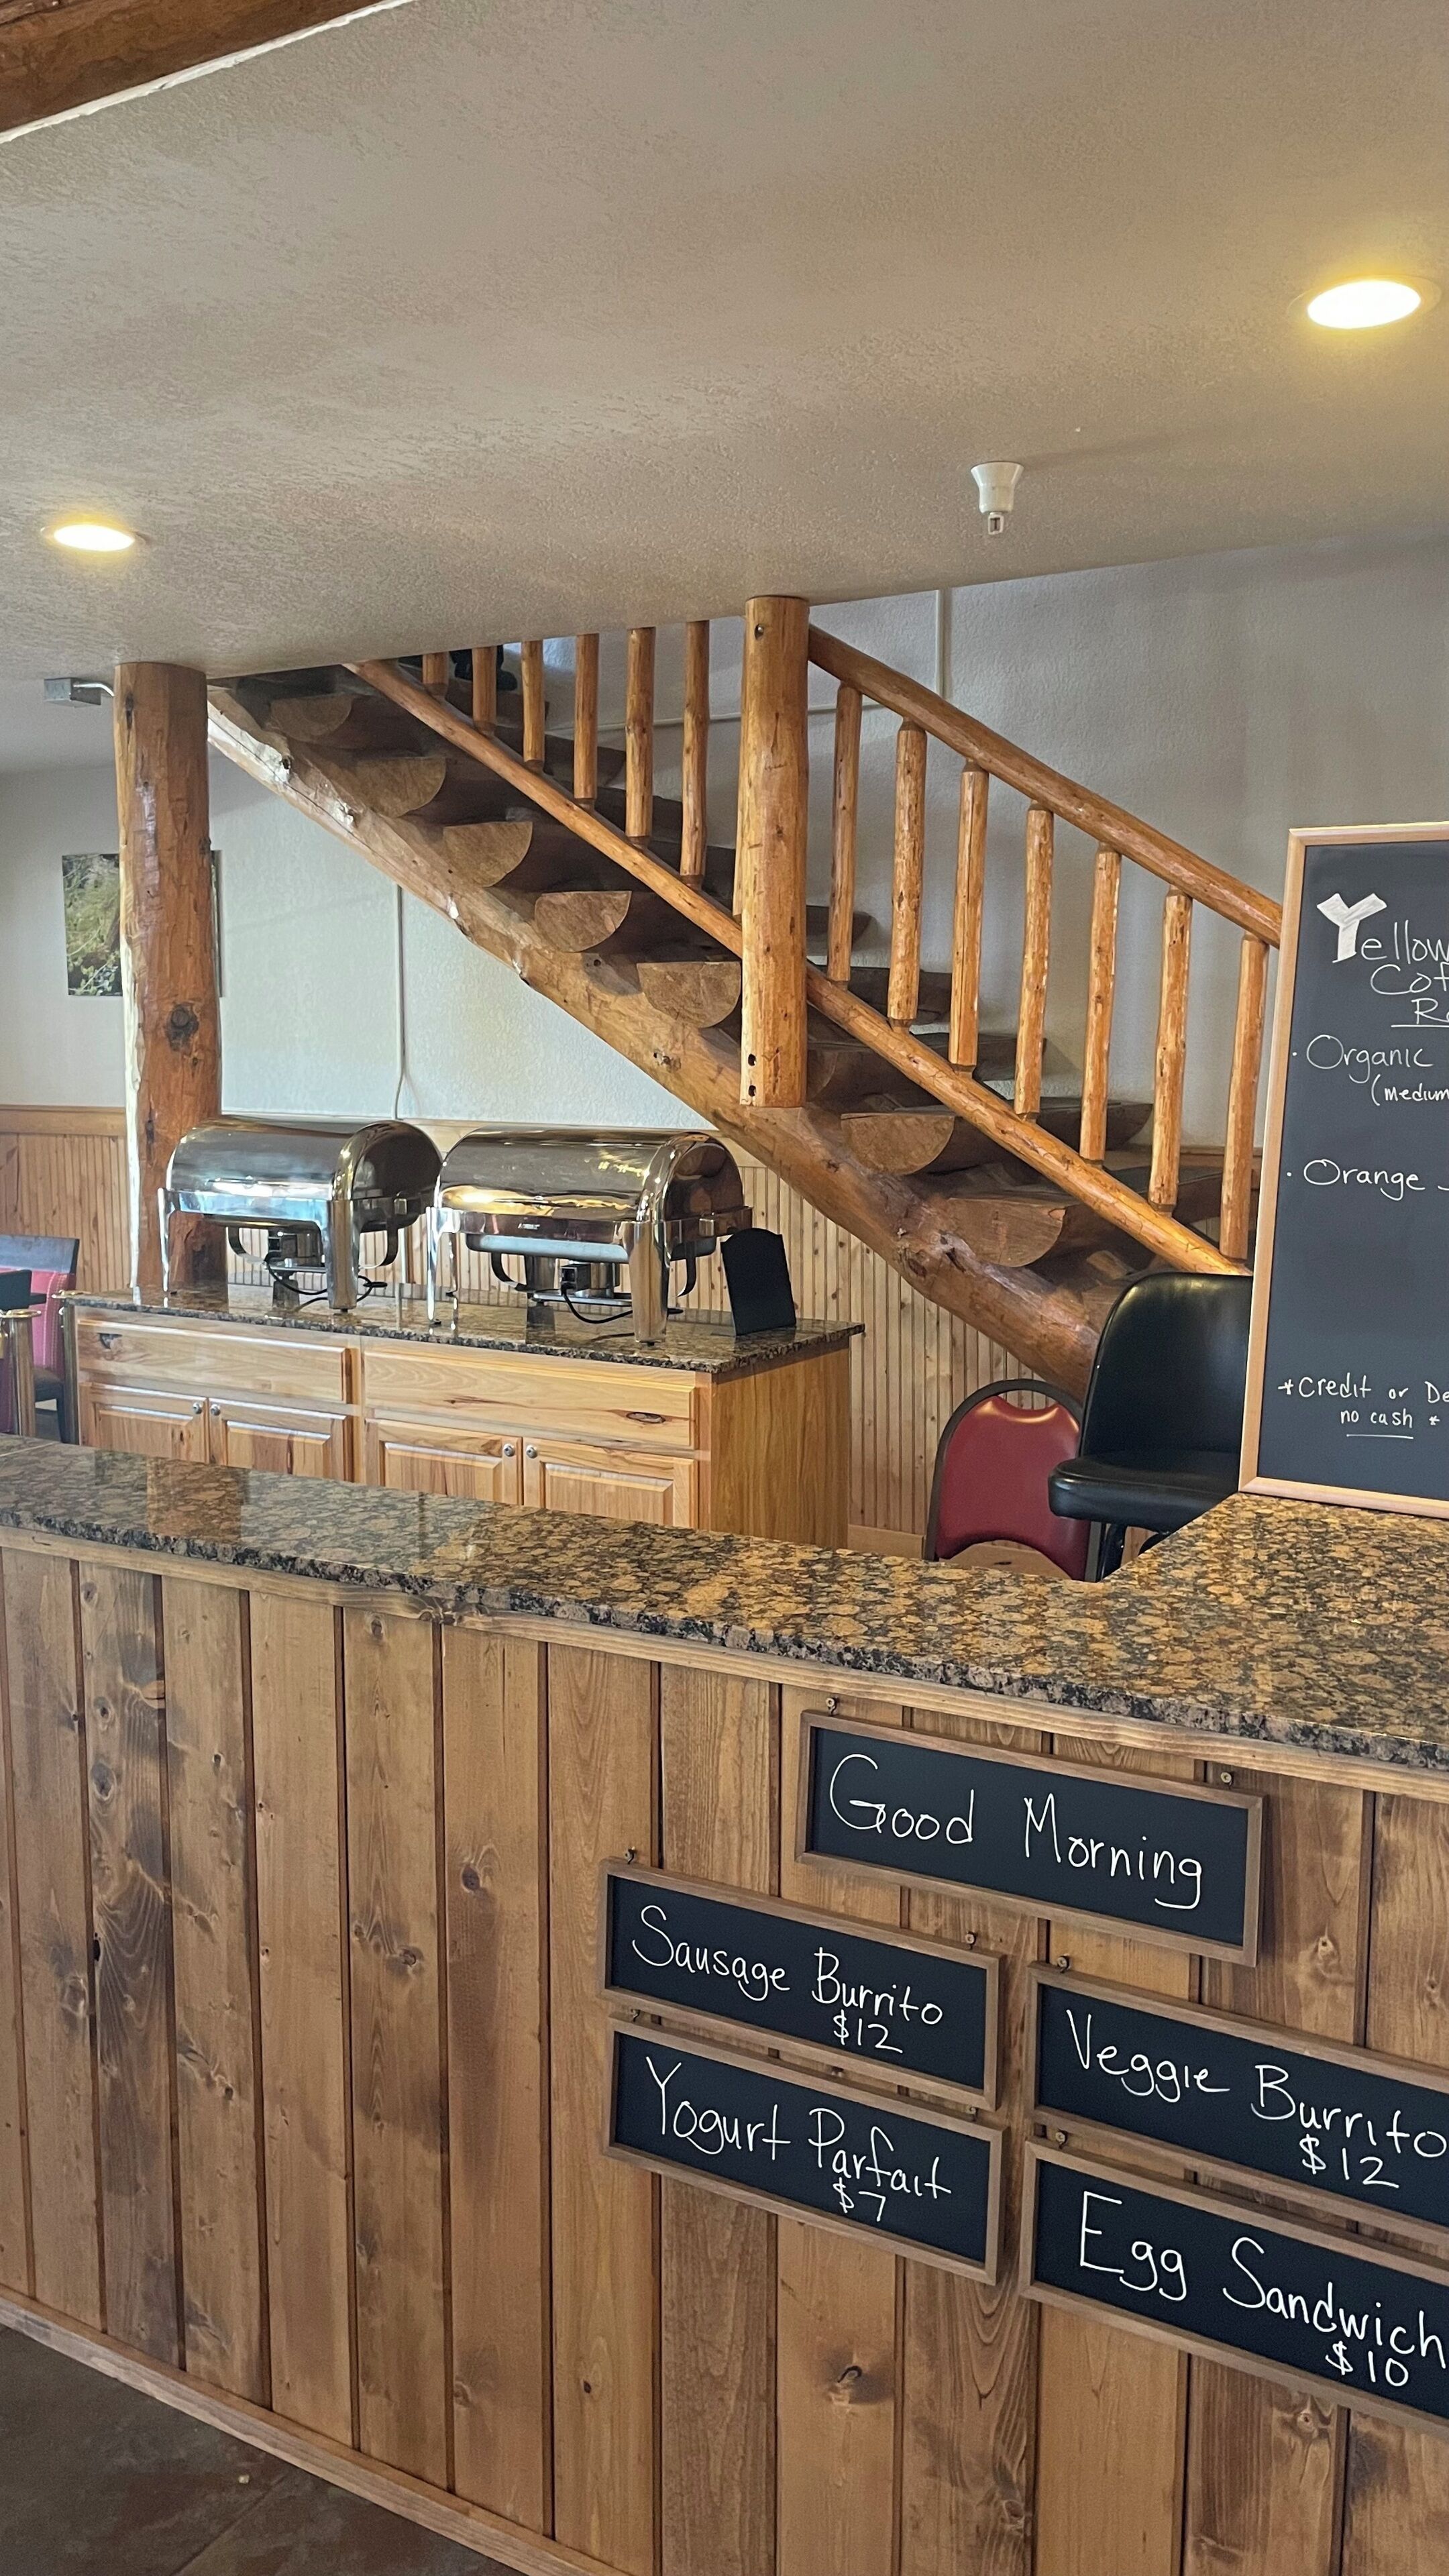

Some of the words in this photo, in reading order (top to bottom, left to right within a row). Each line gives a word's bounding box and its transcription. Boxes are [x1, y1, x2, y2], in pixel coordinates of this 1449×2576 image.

[1316, 893, 1449, 965] Yellow
[1411, 998, 1449, 1024] R
[1306, 1034, 1434, 1084] Organic
[1303, 1159, 1426, 1201] Orange
[1340, 1410, 1359, 1424] no
[1370, 1408, 1413, 1428] cash
[1388, 1387, 1409, 1399] or
[829, 1754, 974, 1844] Good
[1024, 1792, 1202, 1909] Morning
[632, 1904, 790, 2001] Sausage
[811, 1947, 943, 2025] Burrito
[833, 2008, 903, 2053] $12
[1066, 2009, 1230, 2103] Veggie
[1250, 2064, 1447, 2158] Burrito
[645, 2056, 791, 2161] Yogurt
[808, 2108, 952, 2199] Parfait
[1299, 2134, 1399, 2189] $12
[833, 2177, 886, 2222] $7
[1079, 2190, 1187, 2301] Egg
[1222, 2237, 1446, 2369] Sandwich
[1325, 2341, 1409, 2387] $10
